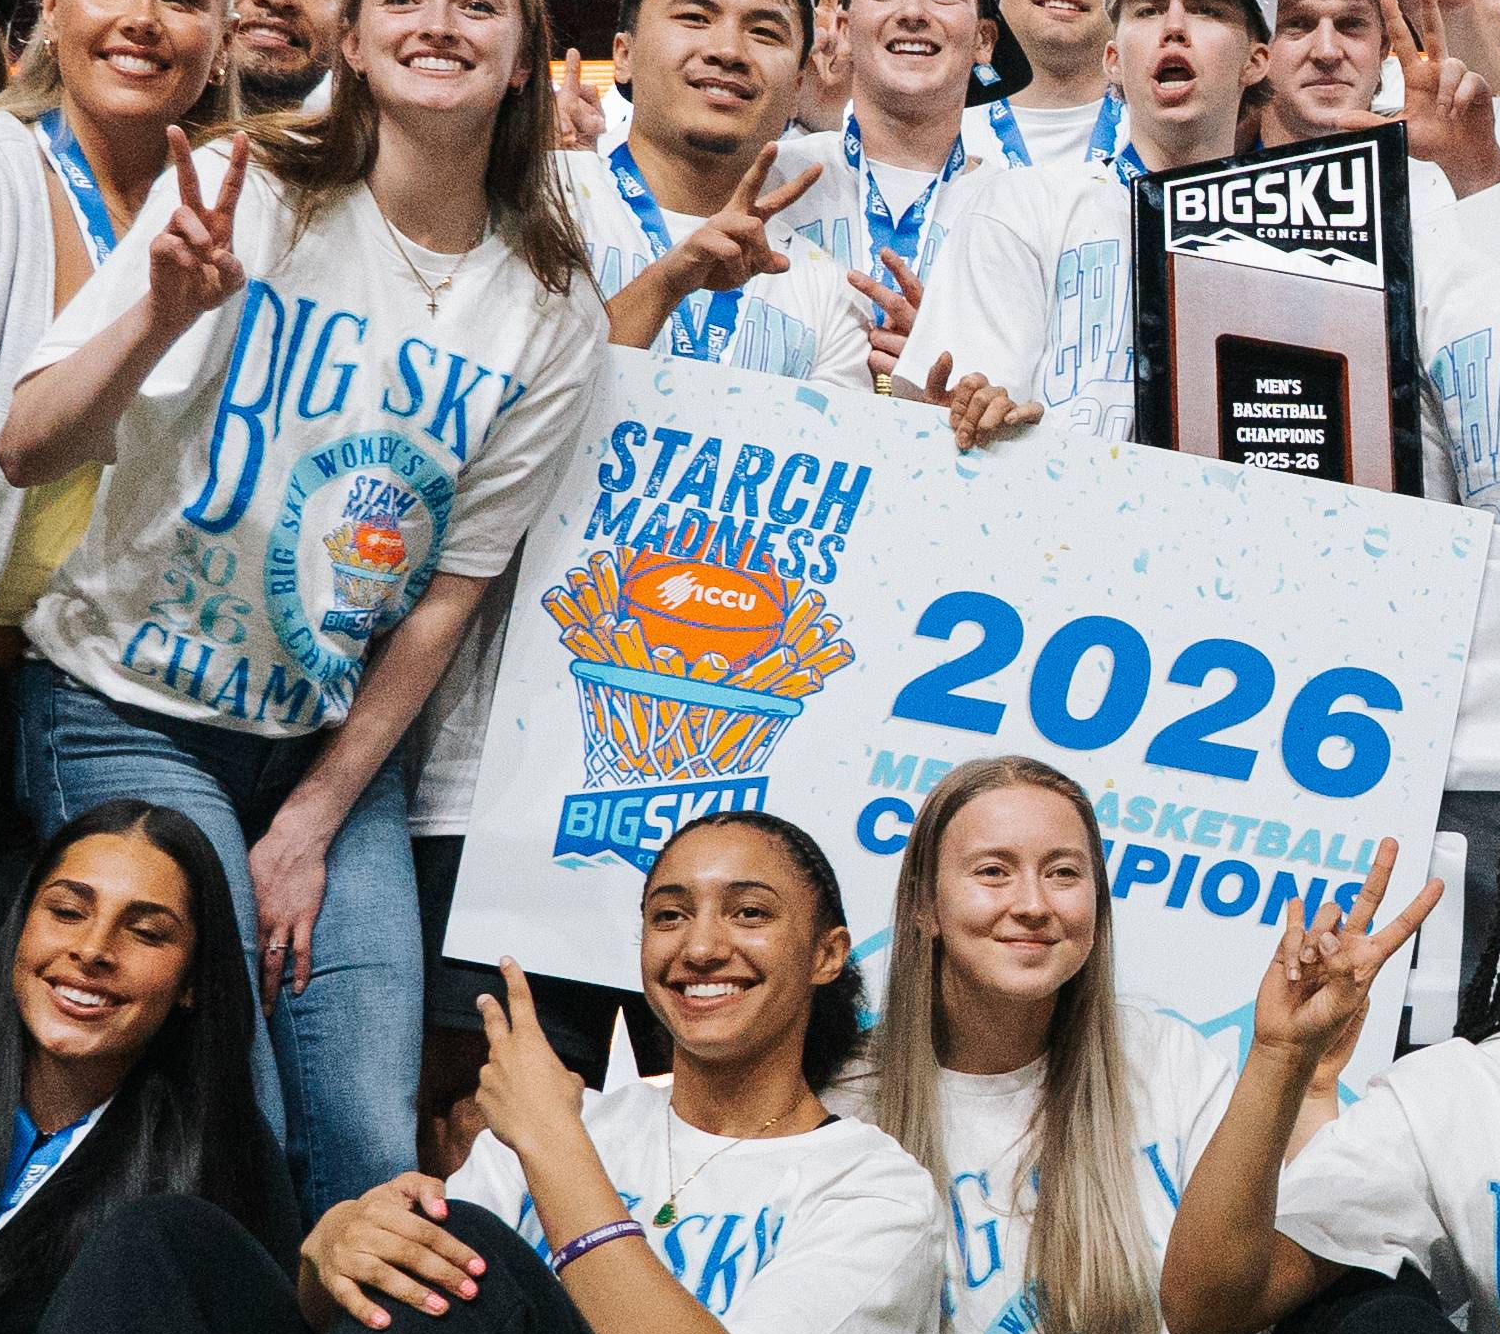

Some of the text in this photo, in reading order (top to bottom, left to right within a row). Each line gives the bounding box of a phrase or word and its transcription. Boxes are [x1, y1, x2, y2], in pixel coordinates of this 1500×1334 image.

[1176, 156, 1369, 227] BIGSKY
[1256, 227, 1369, 242] CONFERENCE
[183, 278, 369, 536] BIG
[1233, 402, 1327, 420] BASKETBALL
[1256, 378, 1302, 396] MEN'S
[1236, 427, 1325, 445] CHAMPIONS
[1244, 451, 1320, 471] 2025-26
[598, 420, 872, 535] STARCH
[270, 544, 297, 597] BIG
[312, 435, 424, 478] WOMEN'S
[583, 491, 846, 585] MADNESS
[692, 585, 758, 612] ICCU
[892, 588, 1404, 799] 2026
[1097, 789, 1384, 875] ASKETBALL
